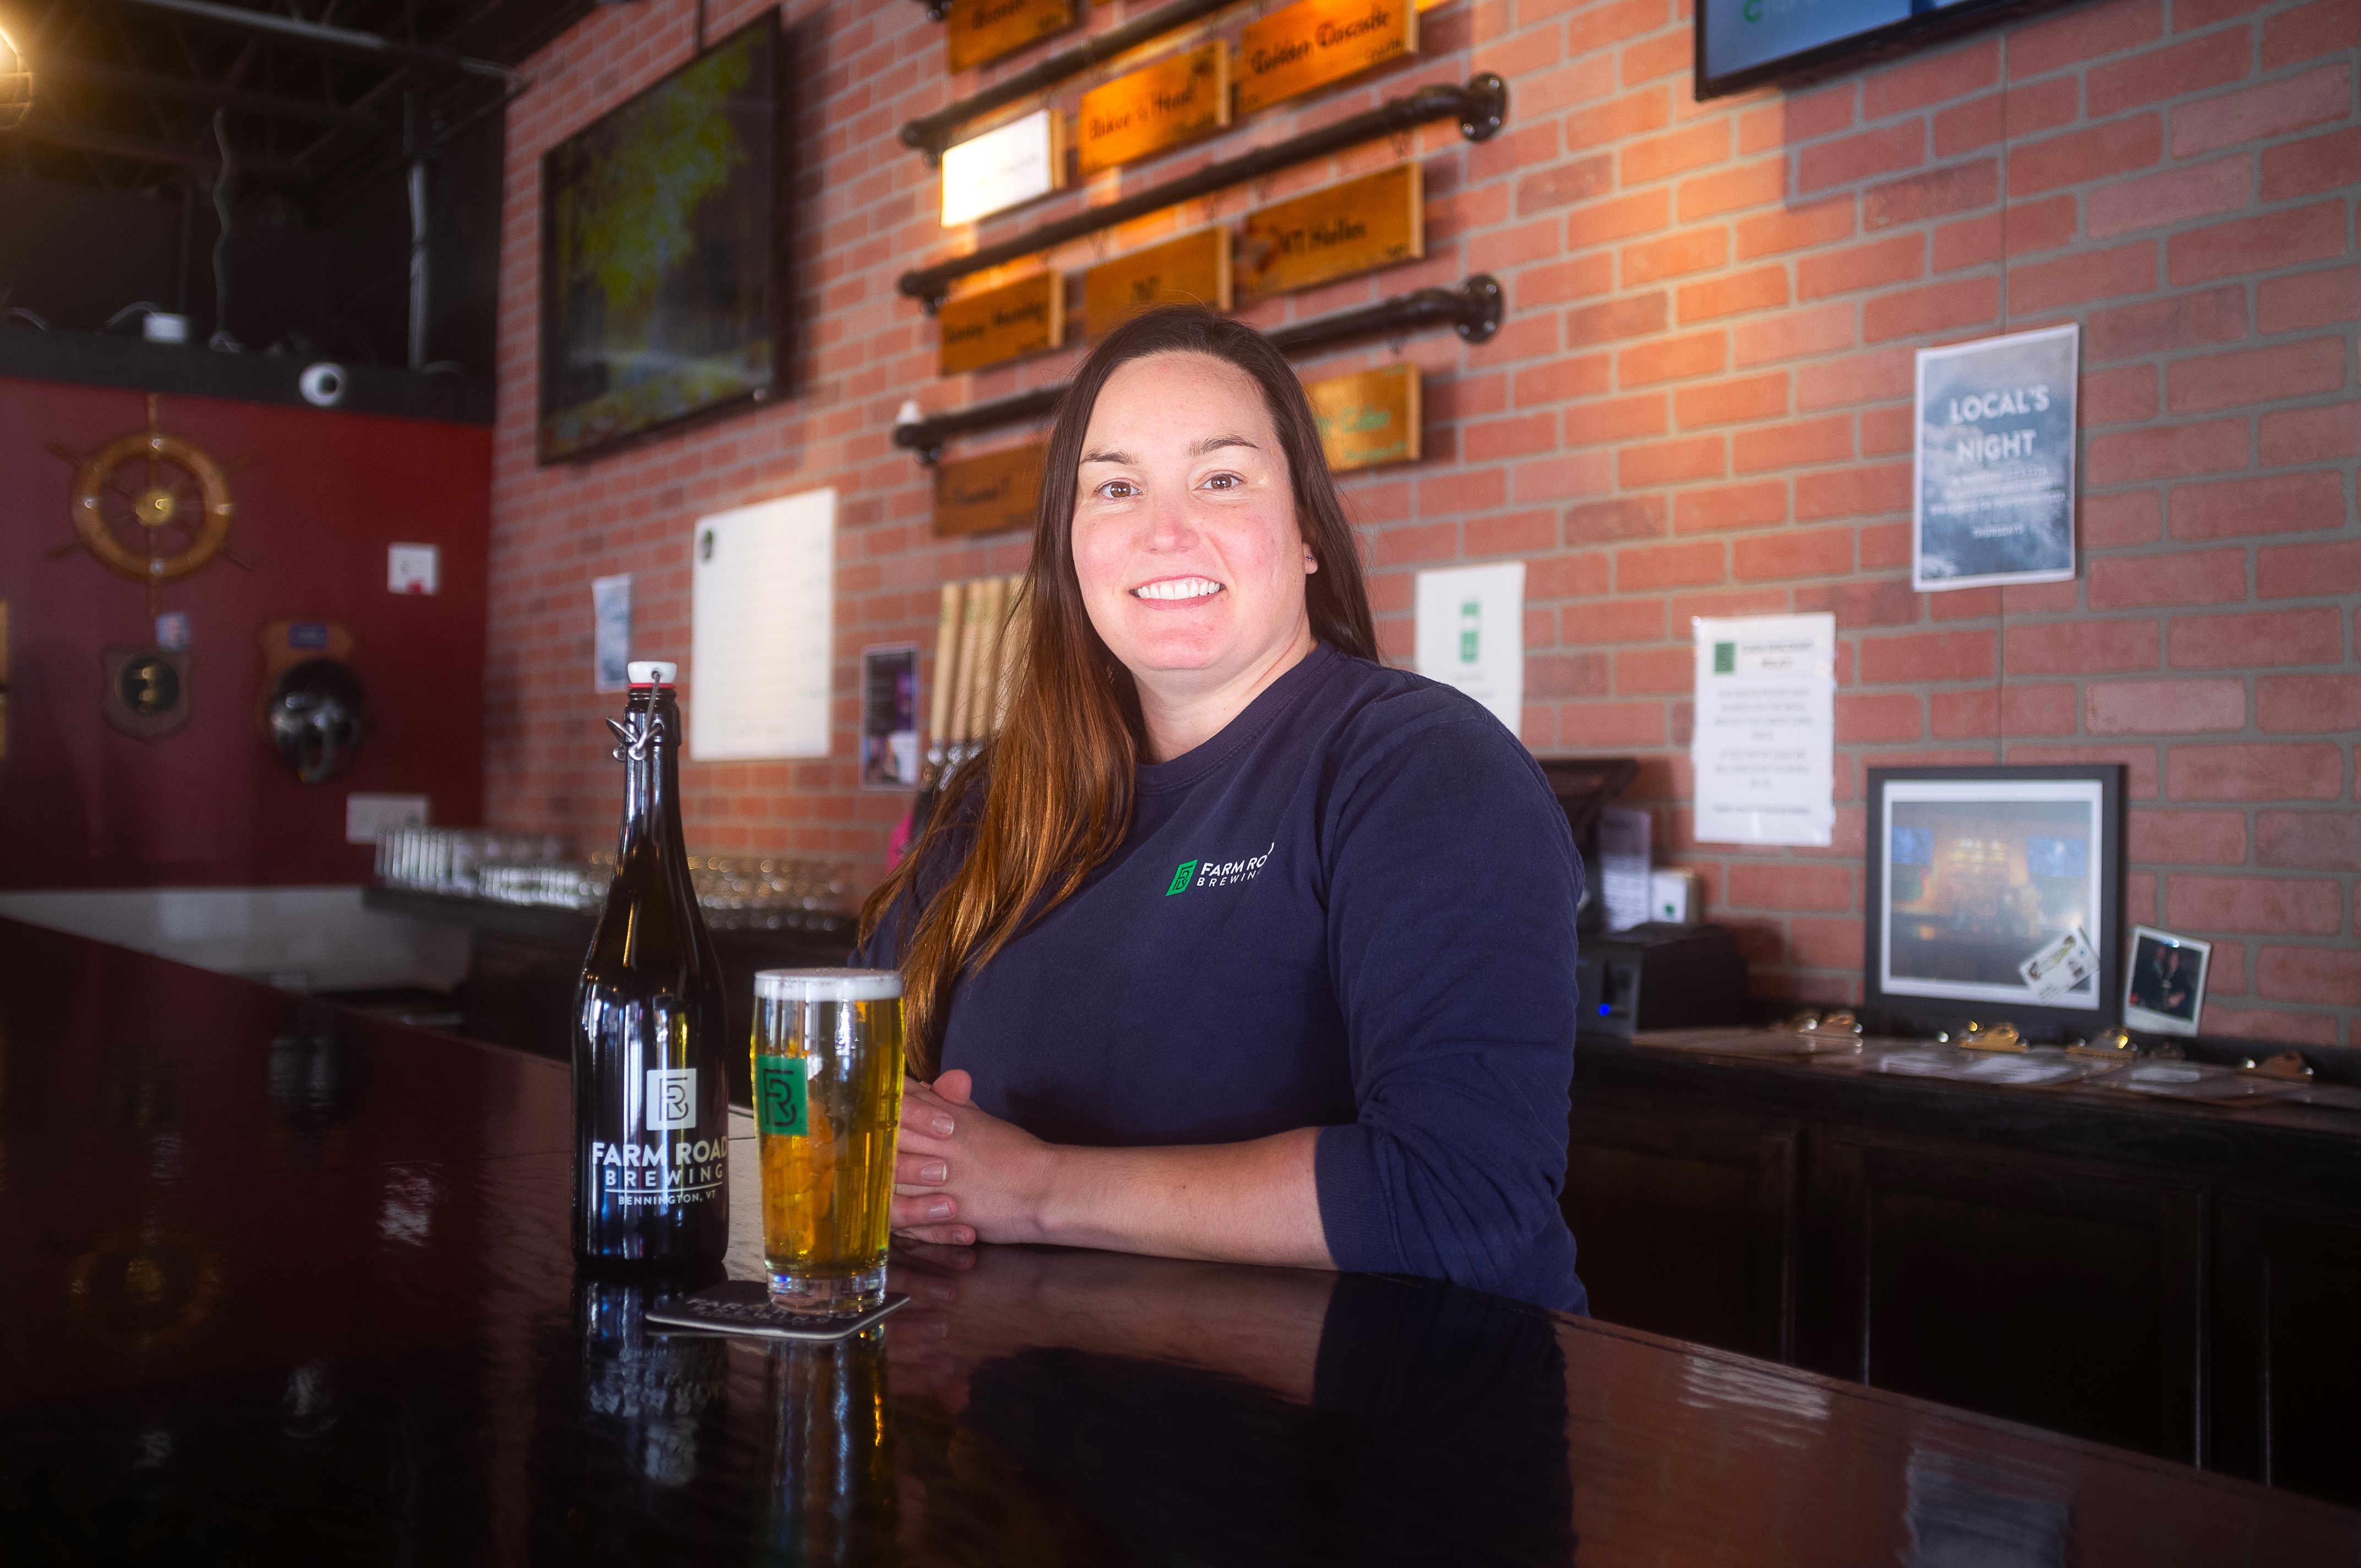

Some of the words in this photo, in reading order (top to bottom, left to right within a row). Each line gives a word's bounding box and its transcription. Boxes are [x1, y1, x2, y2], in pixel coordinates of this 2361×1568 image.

[1950, 384, 2050, 424] LOCAL'S
[1957, 428, 2037, 464] NIGHT
[1197, 870, 1261, 887] BREWIN
[1201, 860, 1245, 876] FARM
[592, 1141, 667, 1167] FARM
[676, 1136, 728, 1166] ROAD
[606, 1163, 723, 1187] BREWING
[618, 1193, 703, 1205] BENNINGTON,
[706, 1190, 716, 1199] VT
